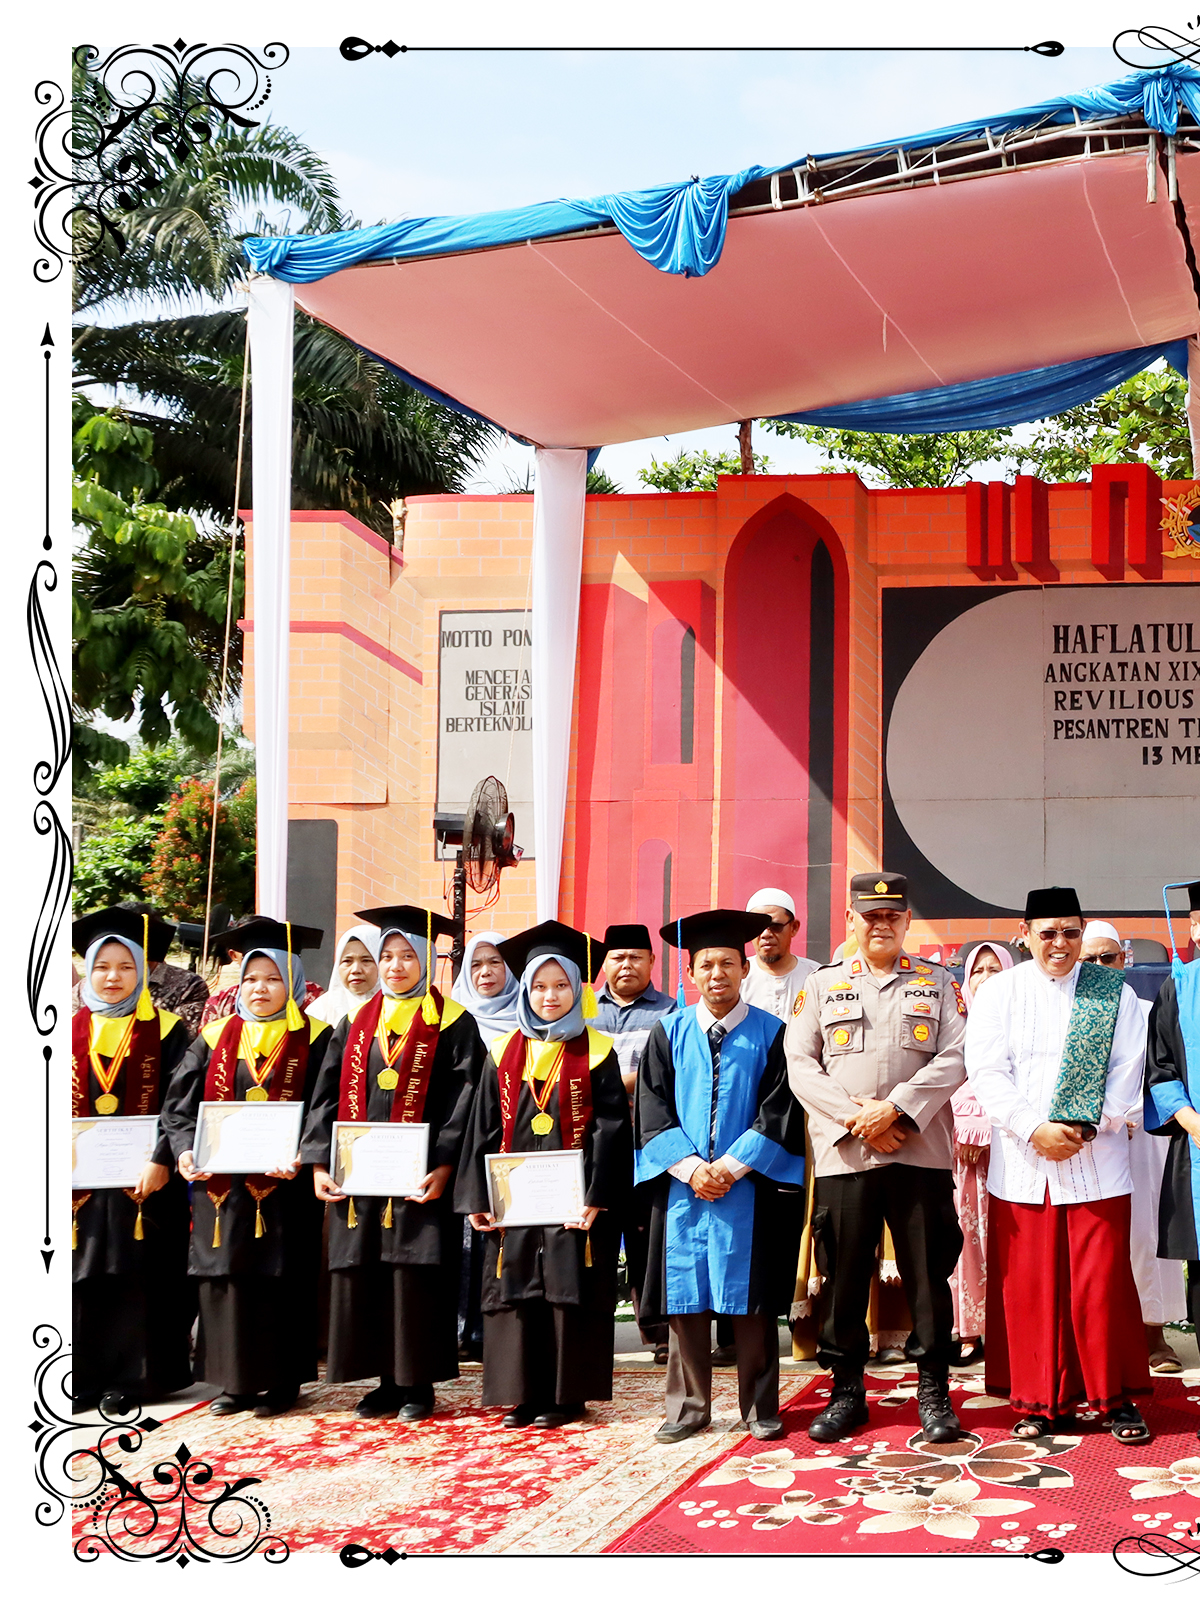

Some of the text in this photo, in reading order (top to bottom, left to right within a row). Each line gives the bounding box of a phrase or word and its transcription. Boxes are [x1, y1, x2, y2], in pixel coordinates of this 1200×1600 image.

[442, 630, 492, 648] MOTTO
[465, 669, 532, 685] MENCETA
[1044, 661, 1161, 683] ANGKATAN
[480, 701, 525, 716] ISLAMI
[1054, 689, 1194, 711] REVILIOUS
[446, 717, 533, 733] BERTEKNOL
[1053, 718, 1169, 740] PESANTREN
[1142, 746, 1163, 766] 13
[825, 993, 859, 1005] ASDI
[904, 990, 939, 999] POLRI
[140, 1054, 156, 1079] Agia
[411, 1041, 428, 1073] Adinda
[283, 1057, 299, 1084] Muna
[403, 1078, 421, 1106] Balqis
